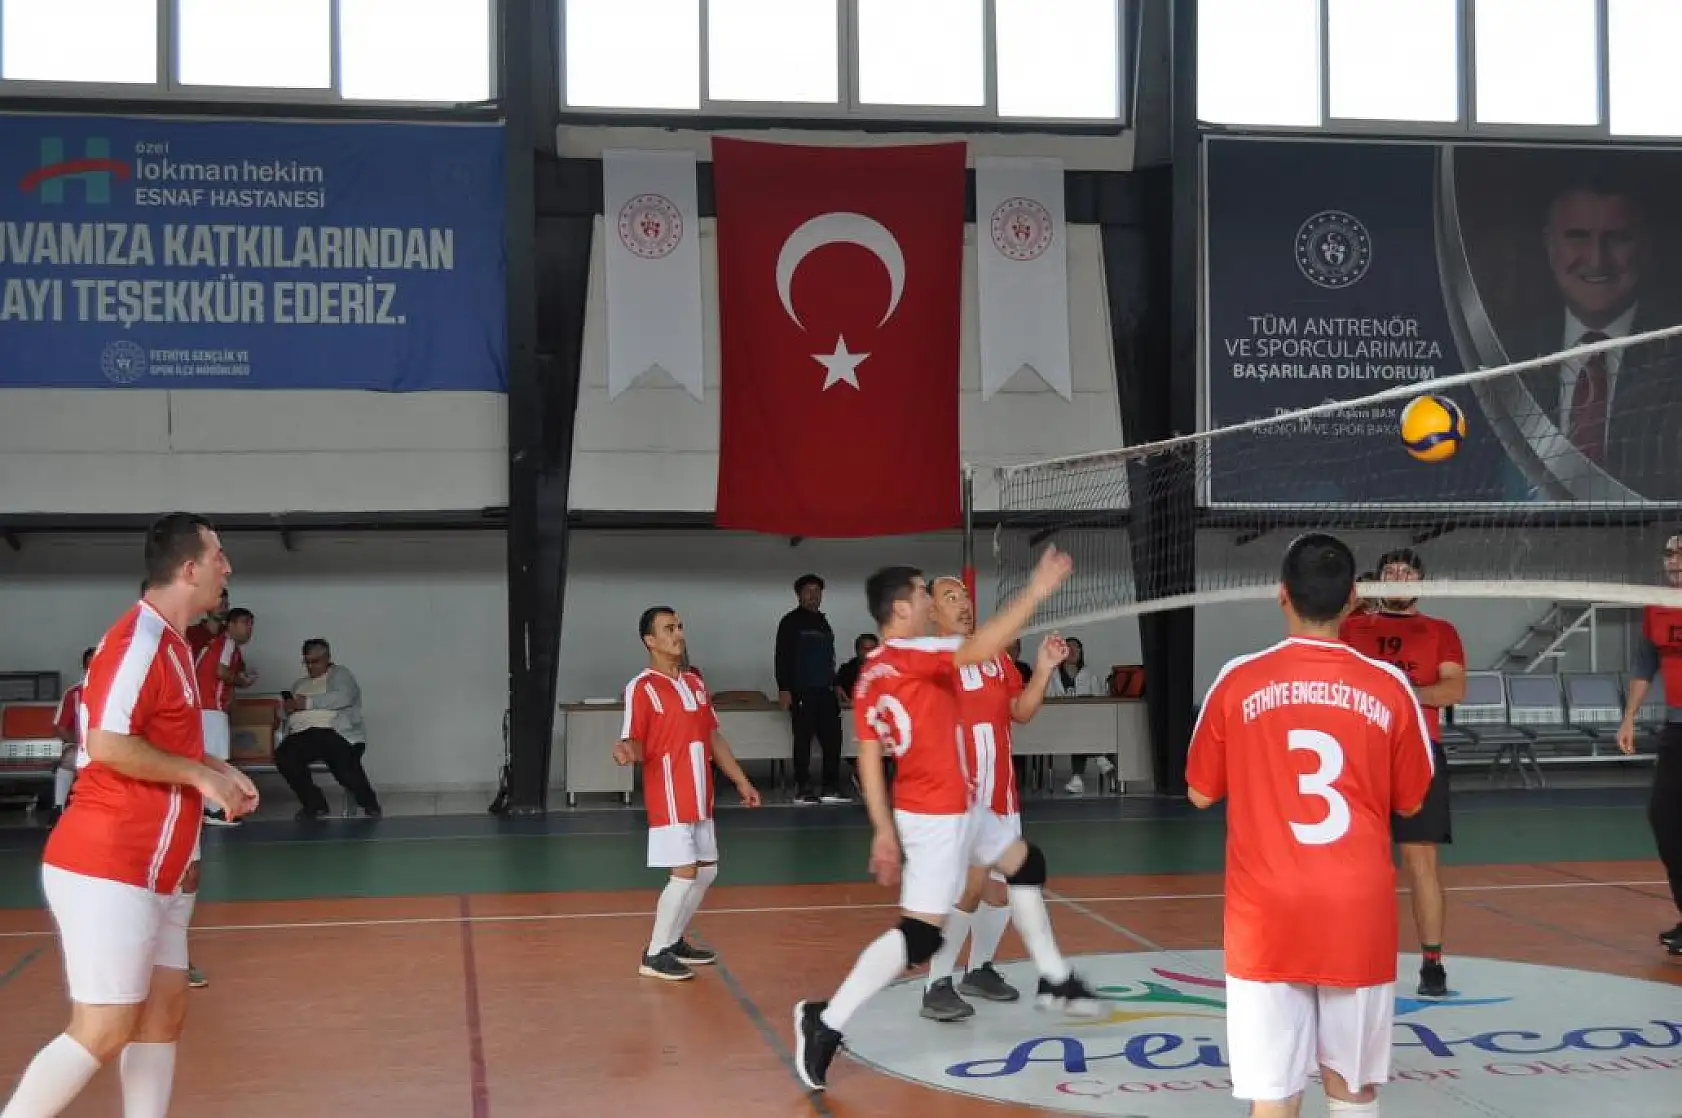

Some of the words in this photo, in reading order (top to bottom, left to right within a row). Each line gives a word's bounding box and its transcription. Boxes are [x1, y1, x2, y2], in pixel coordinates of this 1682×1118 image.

[134, 141, 168, 154] özel
[134, 188, 204, 206] ESNAF
[210, 189, 325, 208] HASTANESİ
[163, 223, 453, 269] KATKILARINDAN
[72, 273, 265, 329] TEŞEKKÜR
[274, 275, 406, 324] EDERİZ.
[1249, 314, 1297, 335] TÜM
[1303, 316, 1418, 337] ANTRENÖR
[1224, 338, 1250, 357] VE
[1256, 338, 1443, 359] SPORCULARIMIZA
[1232, 363, 1332, 382] BAŞARILAR
[1337, 361, 1435, 380] DİLİYORUM
[1376, 635, 1402, 656] 19
[1242, 680, 1290, 725] FETHİYE
[1292, 680, 1351, 710] ENGELSİZ
[1287, 729, 1351, 845] 3
[1056, 1078, 1236, 1098] Çocu
